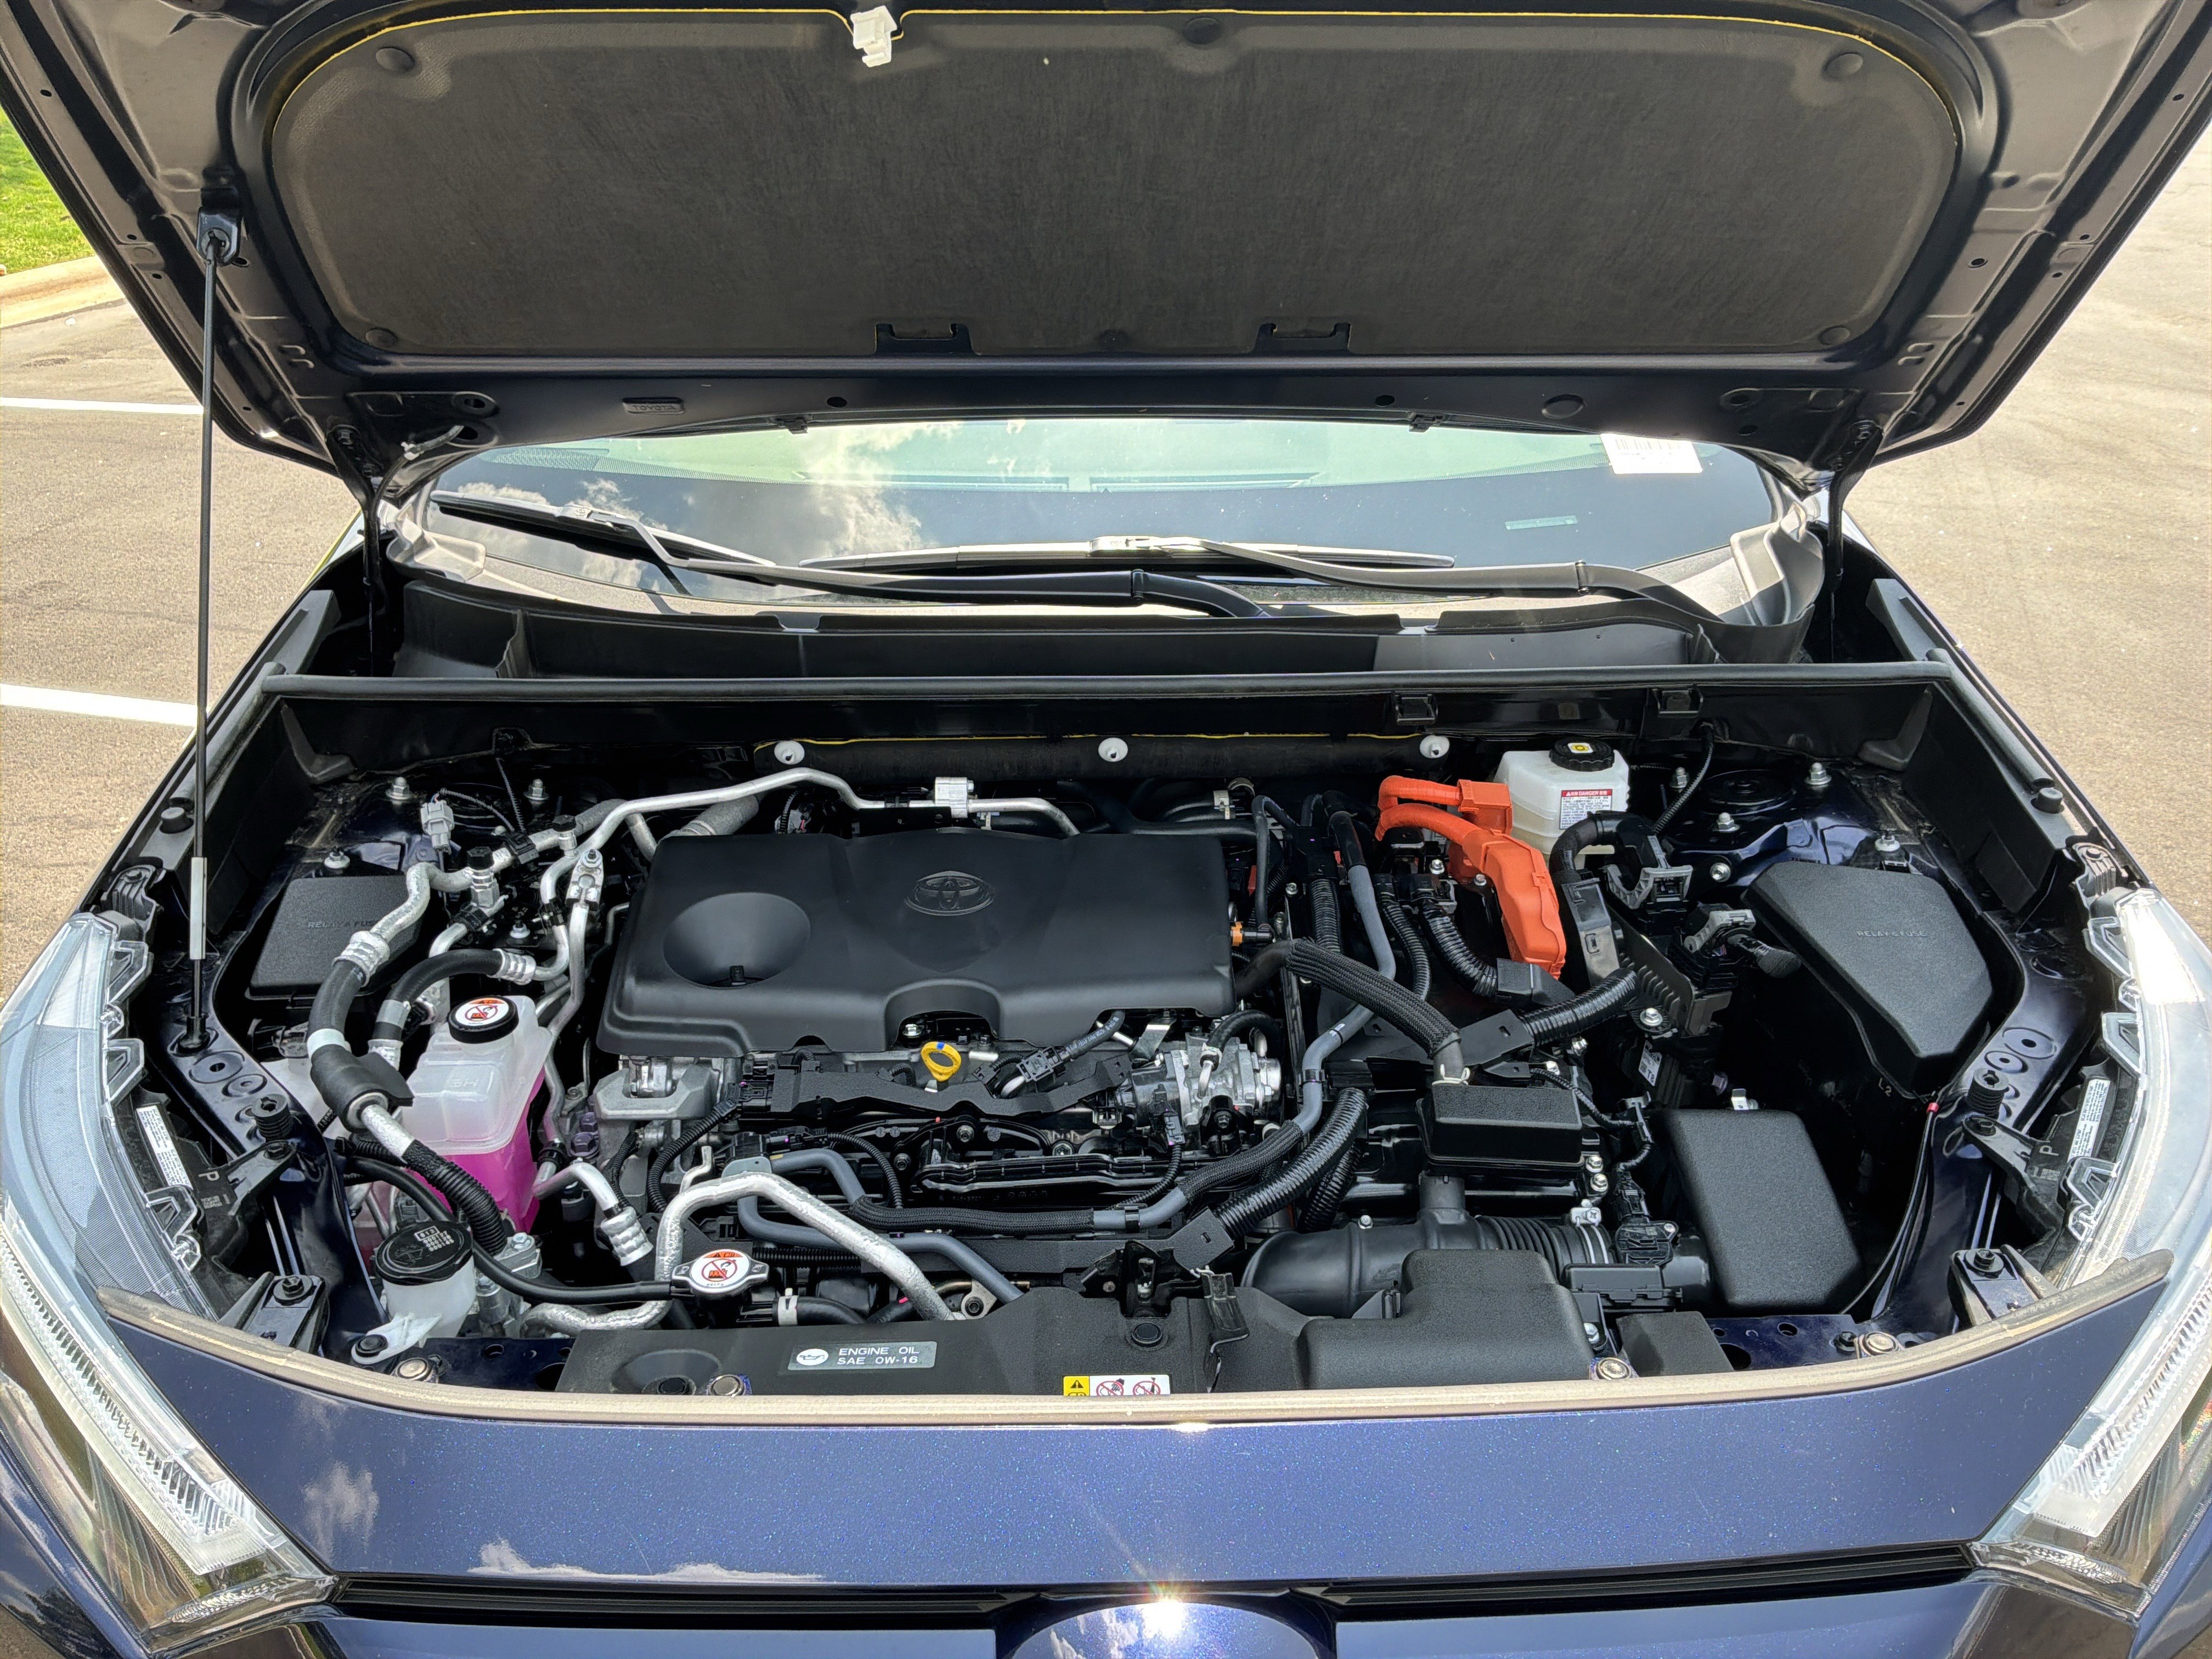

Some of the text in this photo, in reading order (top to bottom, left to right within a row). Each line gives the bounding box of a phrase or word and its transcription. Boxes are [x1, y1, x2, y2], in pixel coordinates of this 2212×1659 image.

[838, 1346, 921, 1356] ENGINE OIL
[837, 1356, 919, 1365] SAE 0W-16
